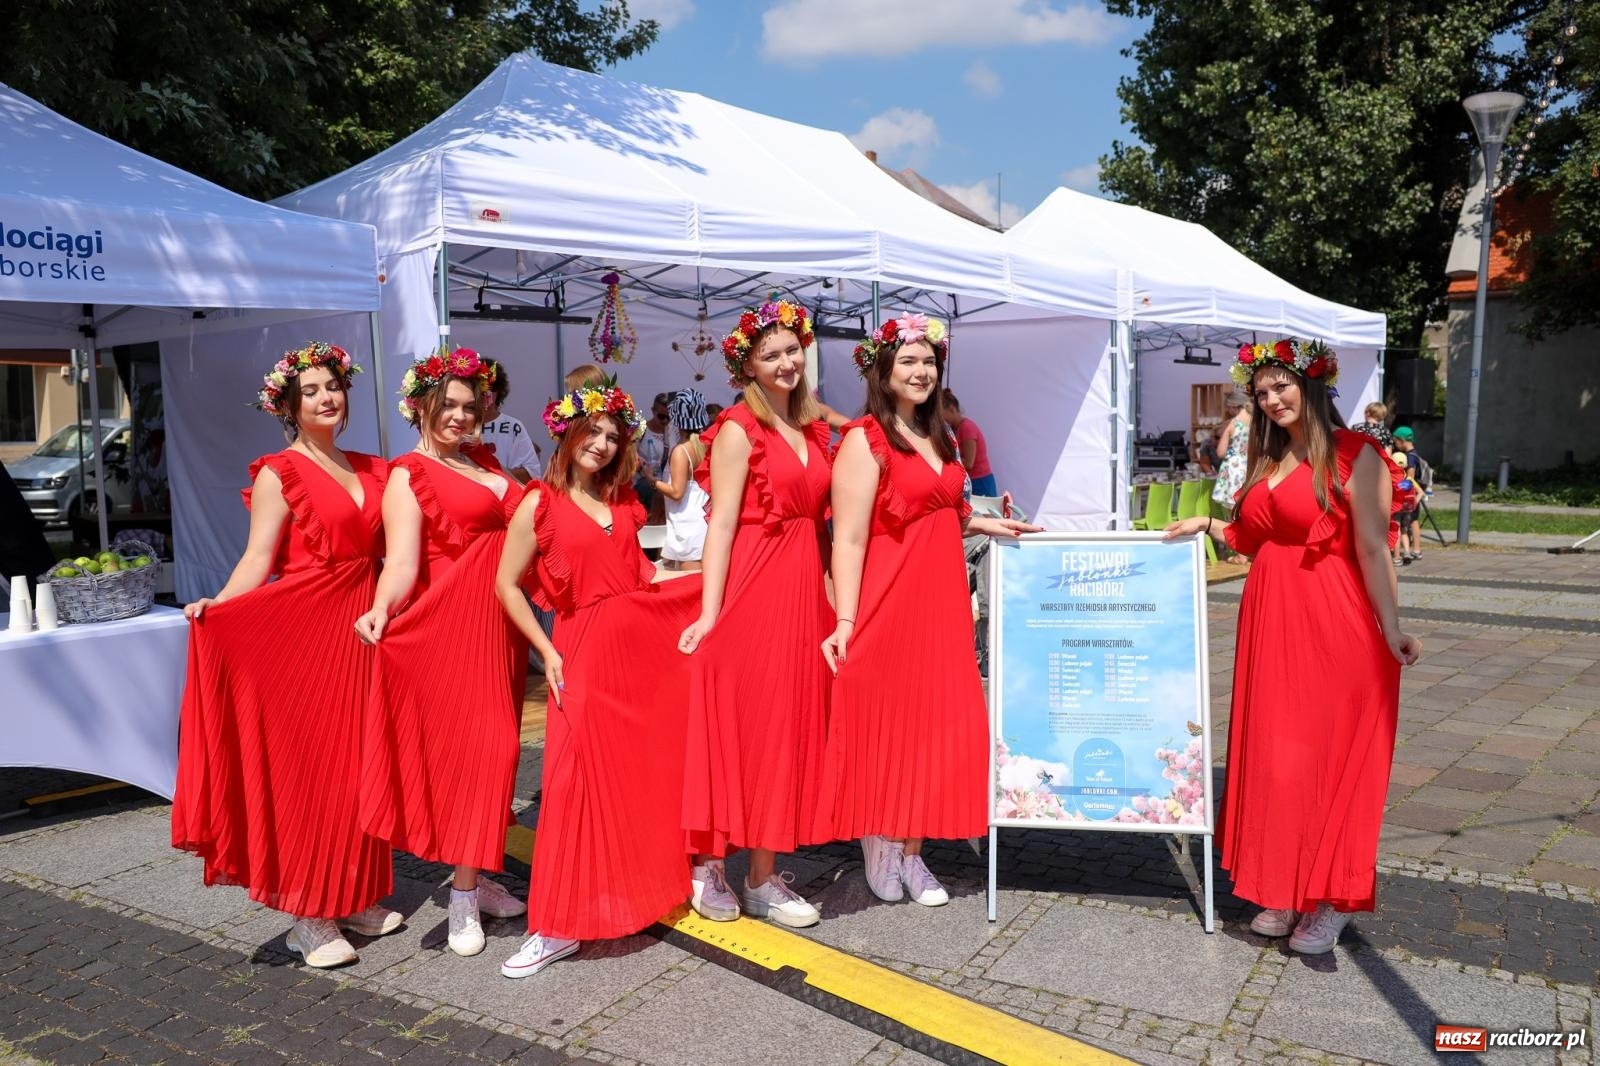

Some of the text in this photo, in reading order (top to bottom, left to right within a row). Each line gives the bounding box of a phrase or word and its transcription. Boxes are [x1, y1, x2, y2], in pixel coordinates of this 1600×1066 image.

[0, 222, 103, 258] ociągi
[1040, 602, 1074, 612] WARSZTATY
[1108, 602, 1156, 612] ARTYSTYCZNEGO
[1062, 639, 1091, 648] PROGRAM
